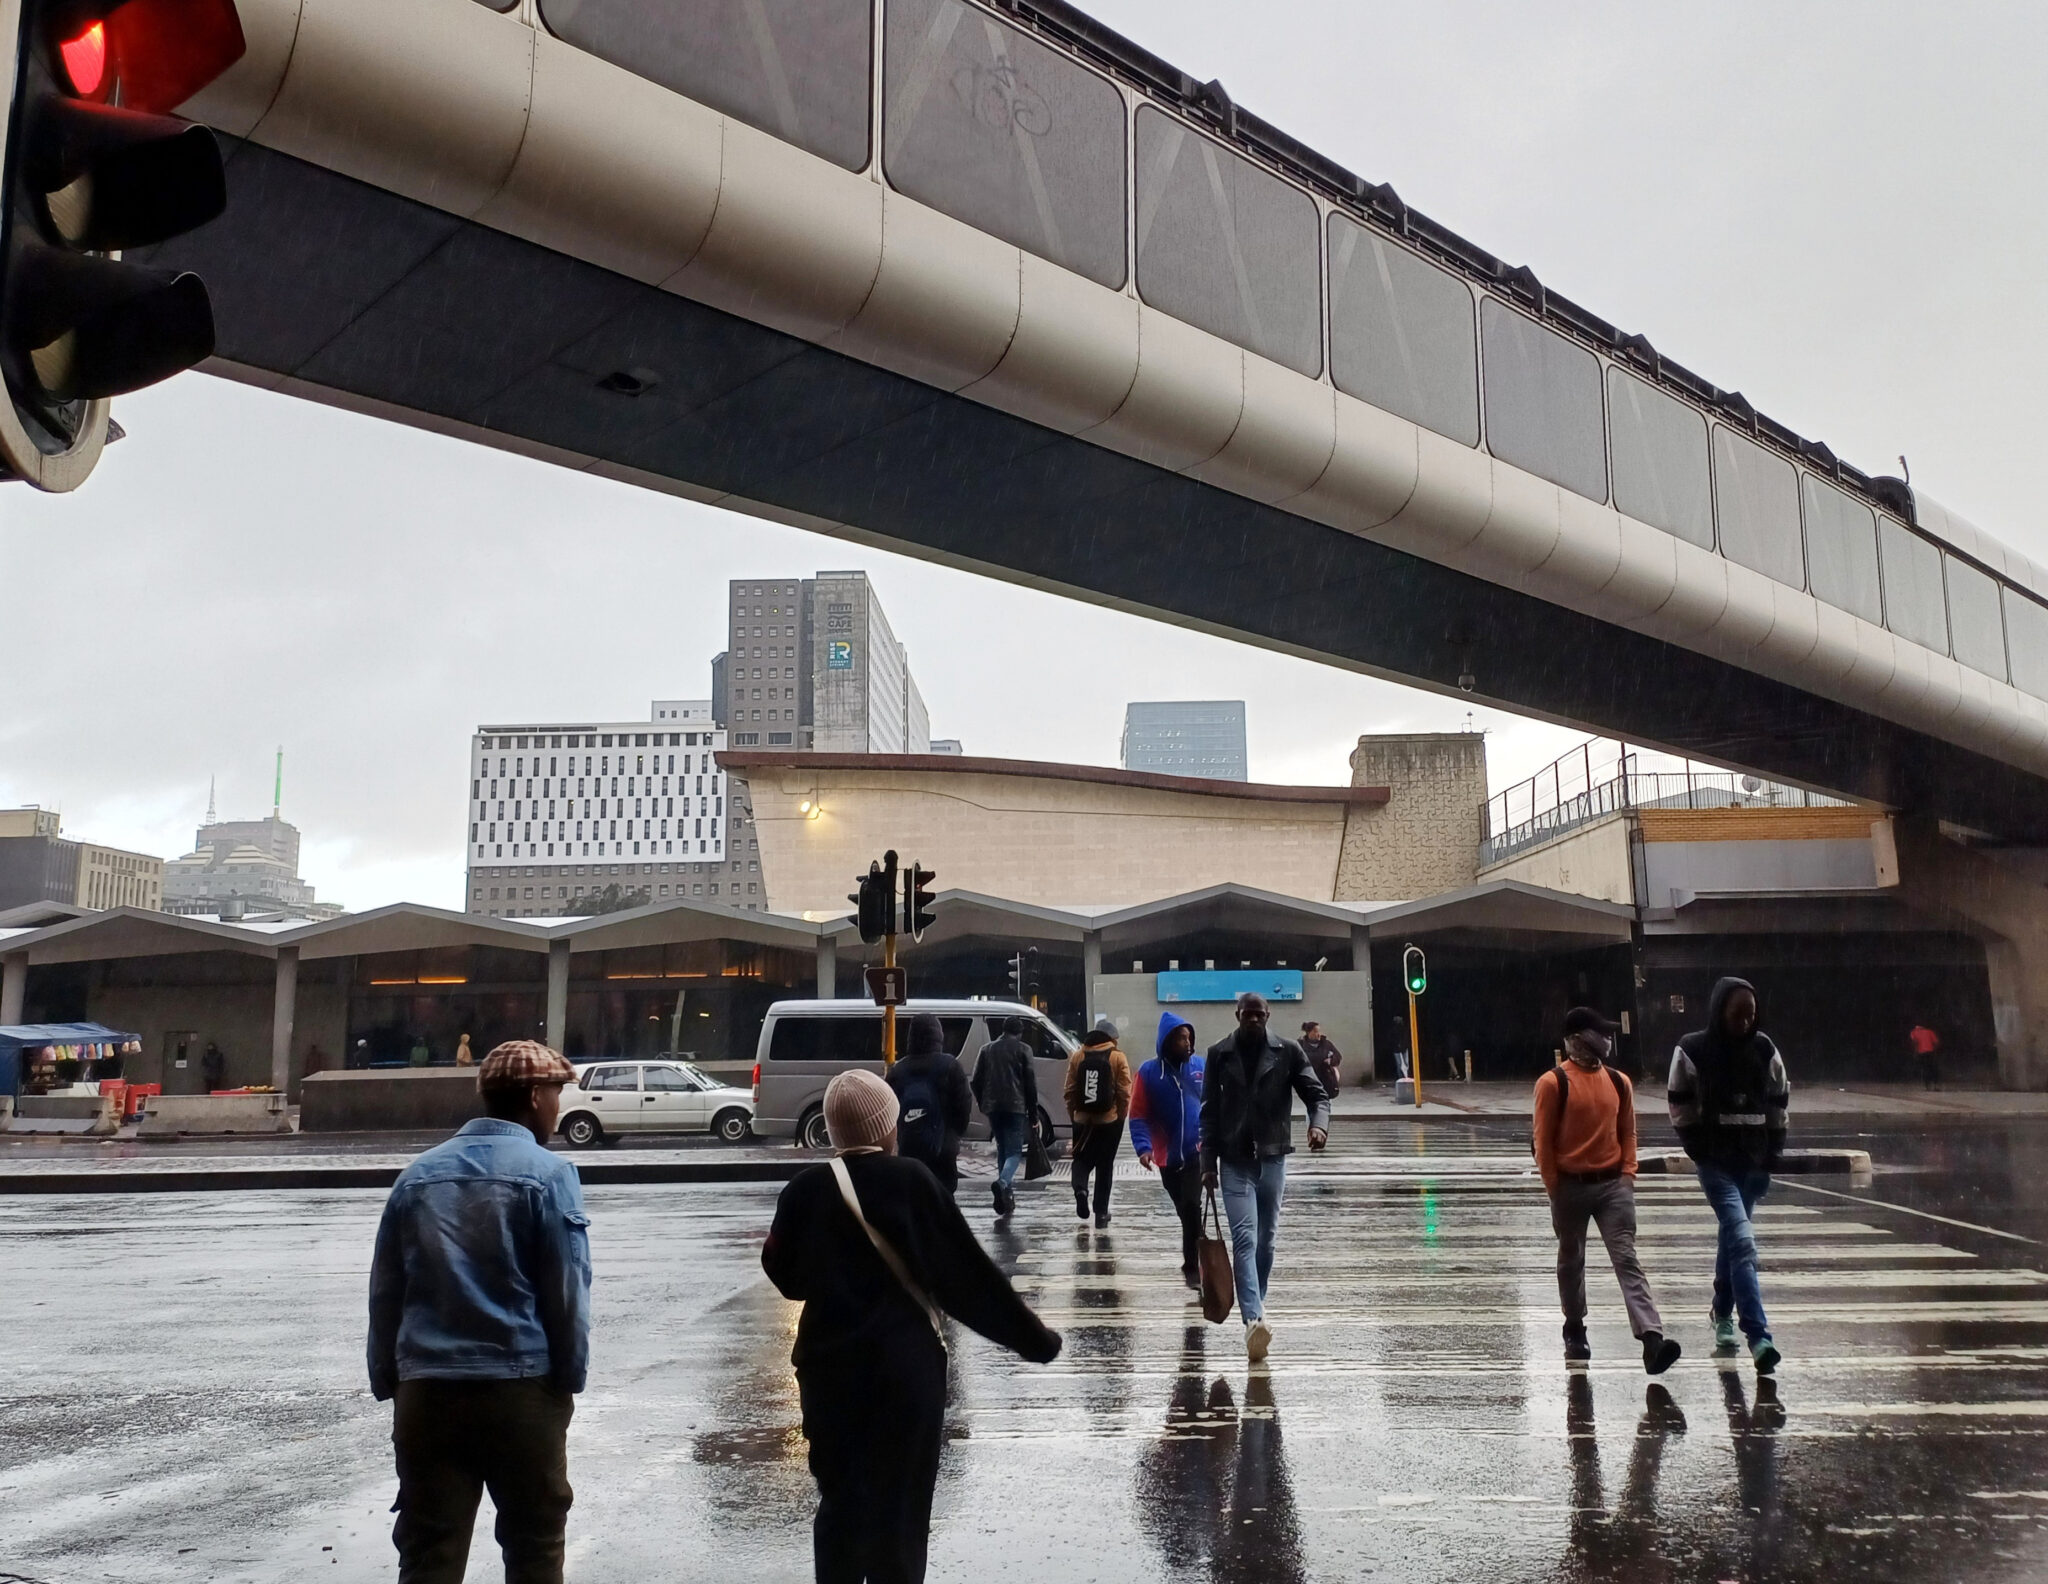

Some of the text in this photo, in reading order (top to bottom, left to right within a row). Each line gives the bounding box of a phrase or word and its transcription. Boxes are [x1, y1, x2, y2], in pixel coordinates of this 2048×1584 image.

[836, 641, 851, 659] R
[884, 973, 898, 1000] i
[1084, 1069, 1099, 1104] VANS
[907, 1108, 924, 1117] NIKE
